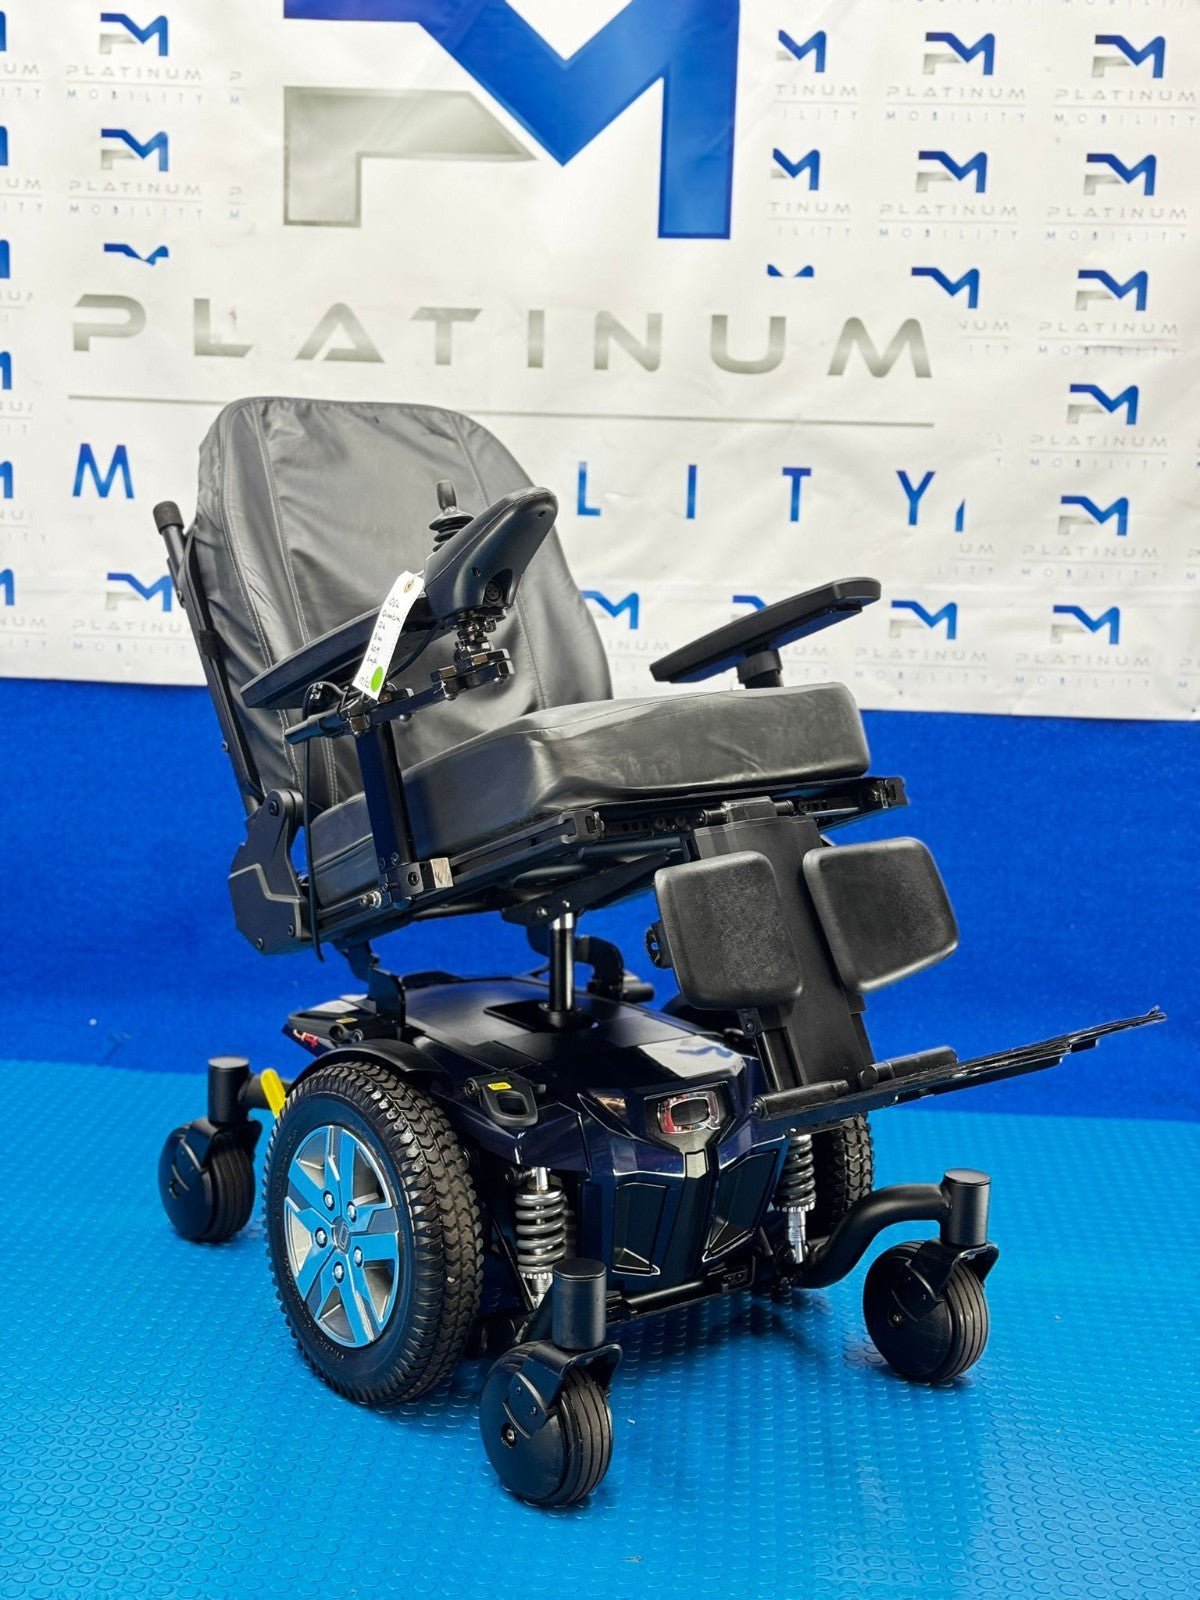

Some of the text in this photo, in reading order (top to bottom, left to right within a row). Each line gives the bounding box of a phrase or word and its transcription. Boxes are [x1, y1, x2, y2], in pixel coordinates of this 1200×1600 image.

[66, 65, 200, 80] PLATINUM
[67, 89, 202, 103] MOBILITY
[886, 86, 1025, 99] PLATINUM
[1055, 89, 1195, 102] PLATINUM
[886, 111, 1025, 122] MOBILITY
[1053, 113, 1195, 126] MOBILITY
[69, 180, 200, 195] PLATINUM
[69, 204, 202, 218] MOBILITY
[879, 204, 1017, 216] PLATINUM
[1047, 207, 1186, 219] PLATINUM
[879, 228, 1017, 239] MOBILITY
[1045, 231, 1186, 241] MOBILITY
[1038, 322, 1177, 334] PLATINUM
[72, 294, 932, 378] PLATINUM
[1030, 435, 1167, 447] PLATINUM
[1030, 458, 1167, 469] MOBILITY
[1022, 545, 1158, 558] PLATINUM
[1021, 568, 1159, 579] MOBILITY
[73, 620, 183, 632] PLATINU
[854, 648, 987, 661] PLATINUM
[1015, 653, 1151, 666] PLATINUM
[854, 671, 987, 681] MOBILITY
[1015, 676, 1150, 688] MOBILITY
